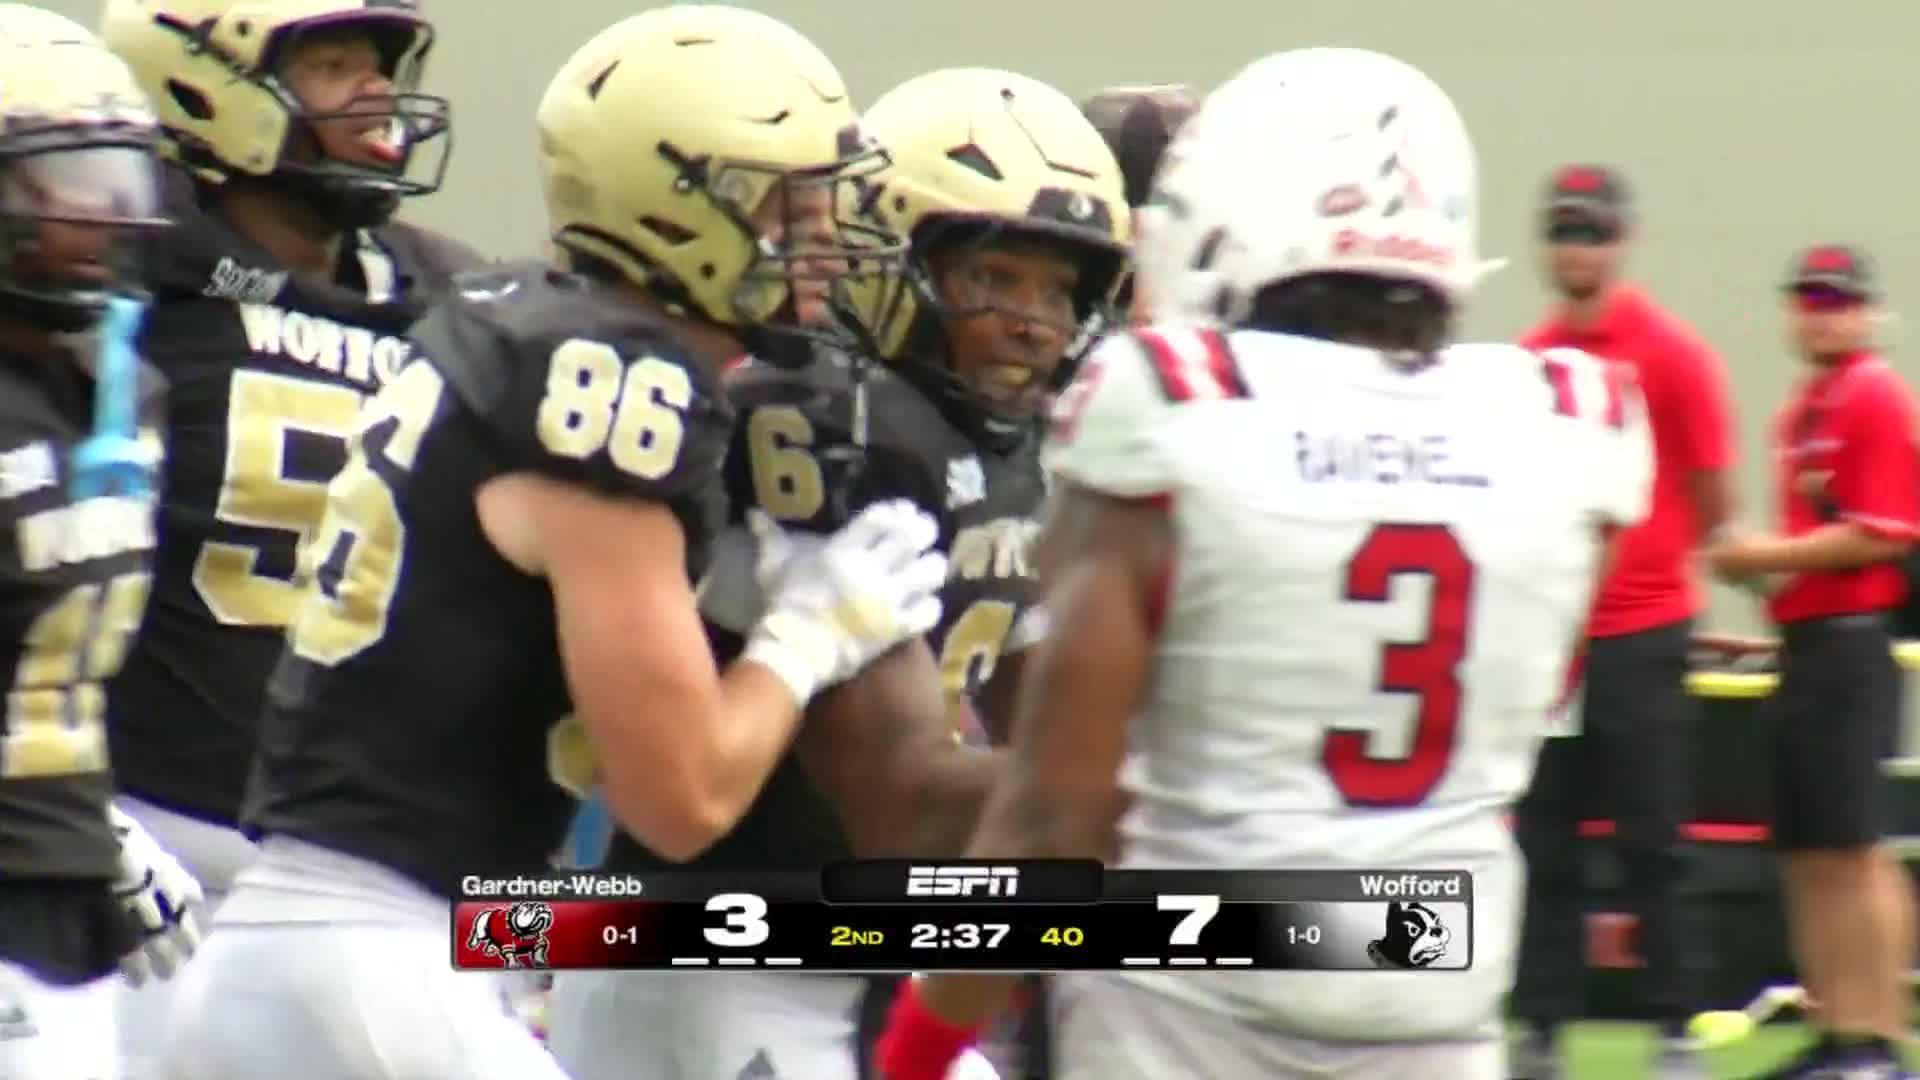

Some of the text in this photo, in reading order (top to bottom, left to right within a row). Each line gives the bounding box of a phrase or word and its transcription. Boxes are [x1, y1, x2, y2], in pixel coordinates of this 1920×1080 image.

[537, 338, 692, 480] 86
[746, 405, 824, 520] 6
[1322, 523, 1478, 808] 3
